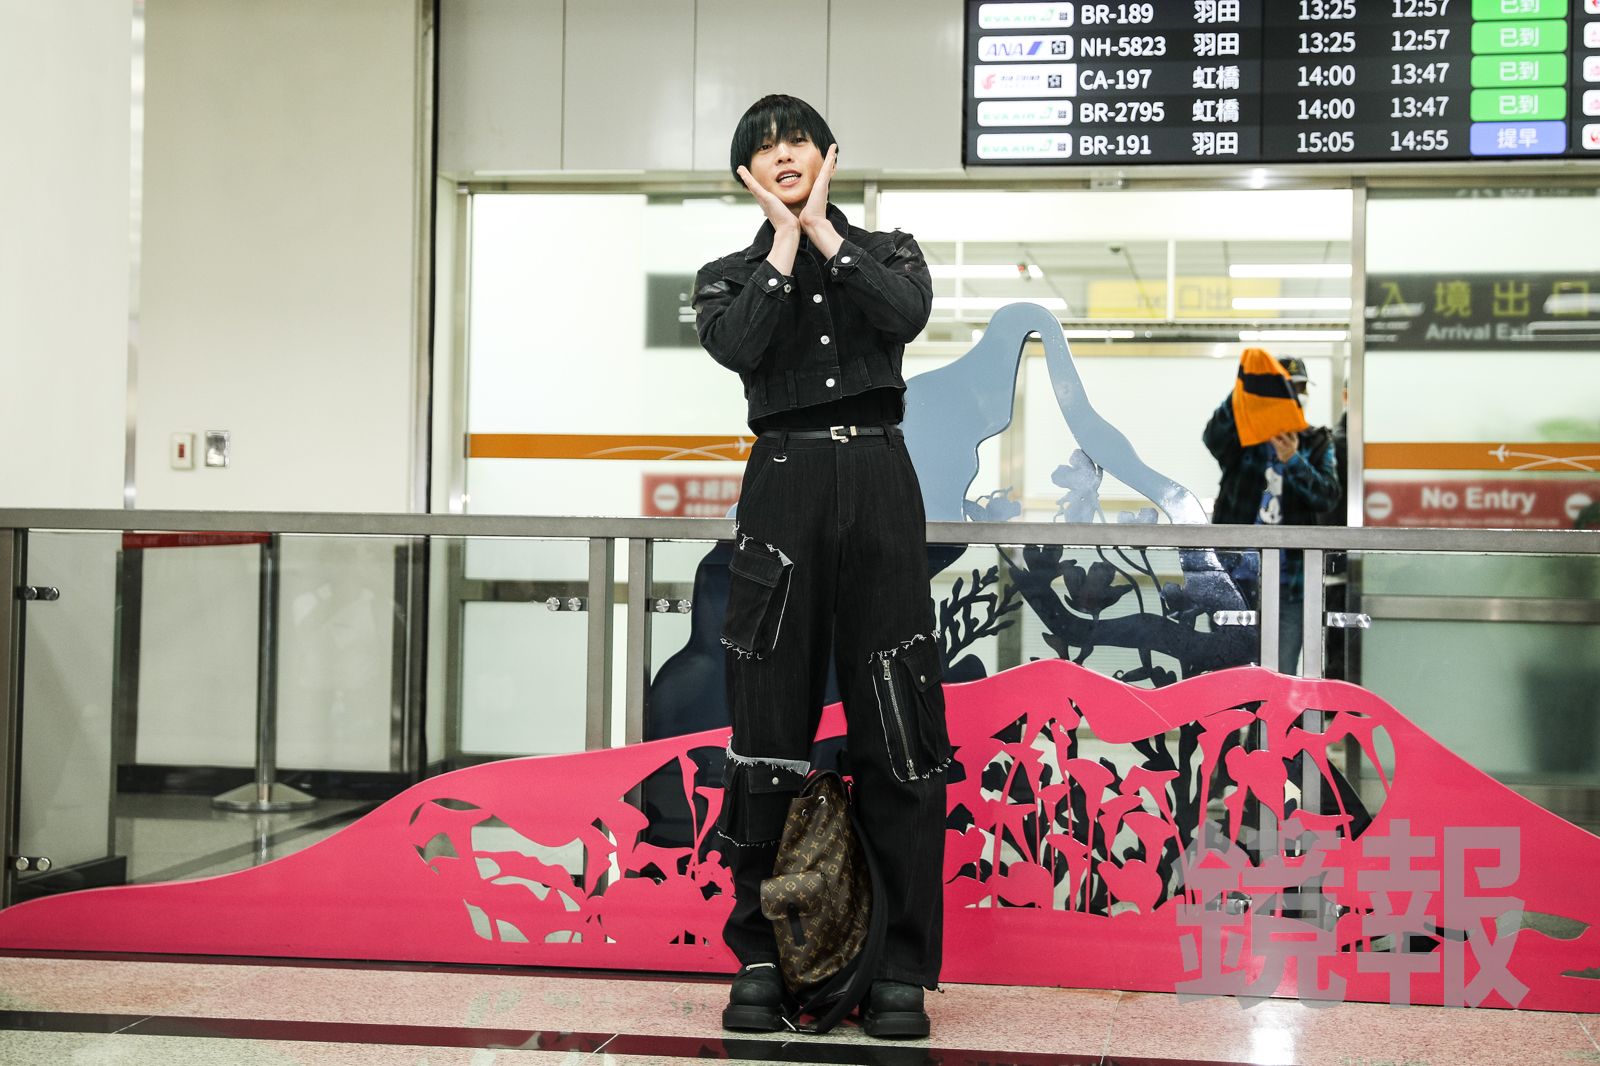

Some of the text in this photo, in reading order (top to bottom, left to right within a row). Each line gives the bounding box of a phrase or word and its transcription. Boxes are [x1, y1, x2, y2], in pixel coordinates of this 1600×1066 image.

[1081, 3, 1154, 24] BR-189
[1194, 0, 1240, 23] 羽田
[1299, 0, 1356, 20] 13:25
[1392, 0, 1449, 18] 12:57
[1081, 36, 1167, 57] NH-5823
[1193, 33, 1240, 56] 羽田
[1298, 32, 1356, 53] 13:25
[1391, 29, 1450, 51] 12:57
[1500, 27, 1540, 48] 已到
[985, 43, 1024, 57] ANA
[1080, 69, 1152, 90] CA-197
[1193, 65, 1240, 90] 虹橋
[1298, 65, 1355, 87] 14:00
[1391, 63, 1449, 84] 13:47
[1500, 61, 1540, 82] 已到
[1080, 102, 1165, 123] BR-2795
[1192, 98, 1240, 123] 虹橋
[1298, 98, 1355, 120] 14:00
[1391, 96, 1449, 118] 13:47
[1500, 94, 1539, 115] 已到
[1080, 135, 1152, 156] BR-191
[1192, 132, 1239, 156] 羽田
[1297, 131, 1354, 153] 15:05
[1390, 130, 1448, 152] 14:55
[1497, 127, 1538, 149] 提早
[1425, 322, 1491, 341] Arrival
[1421, 486, 1536, 515] No Entry
